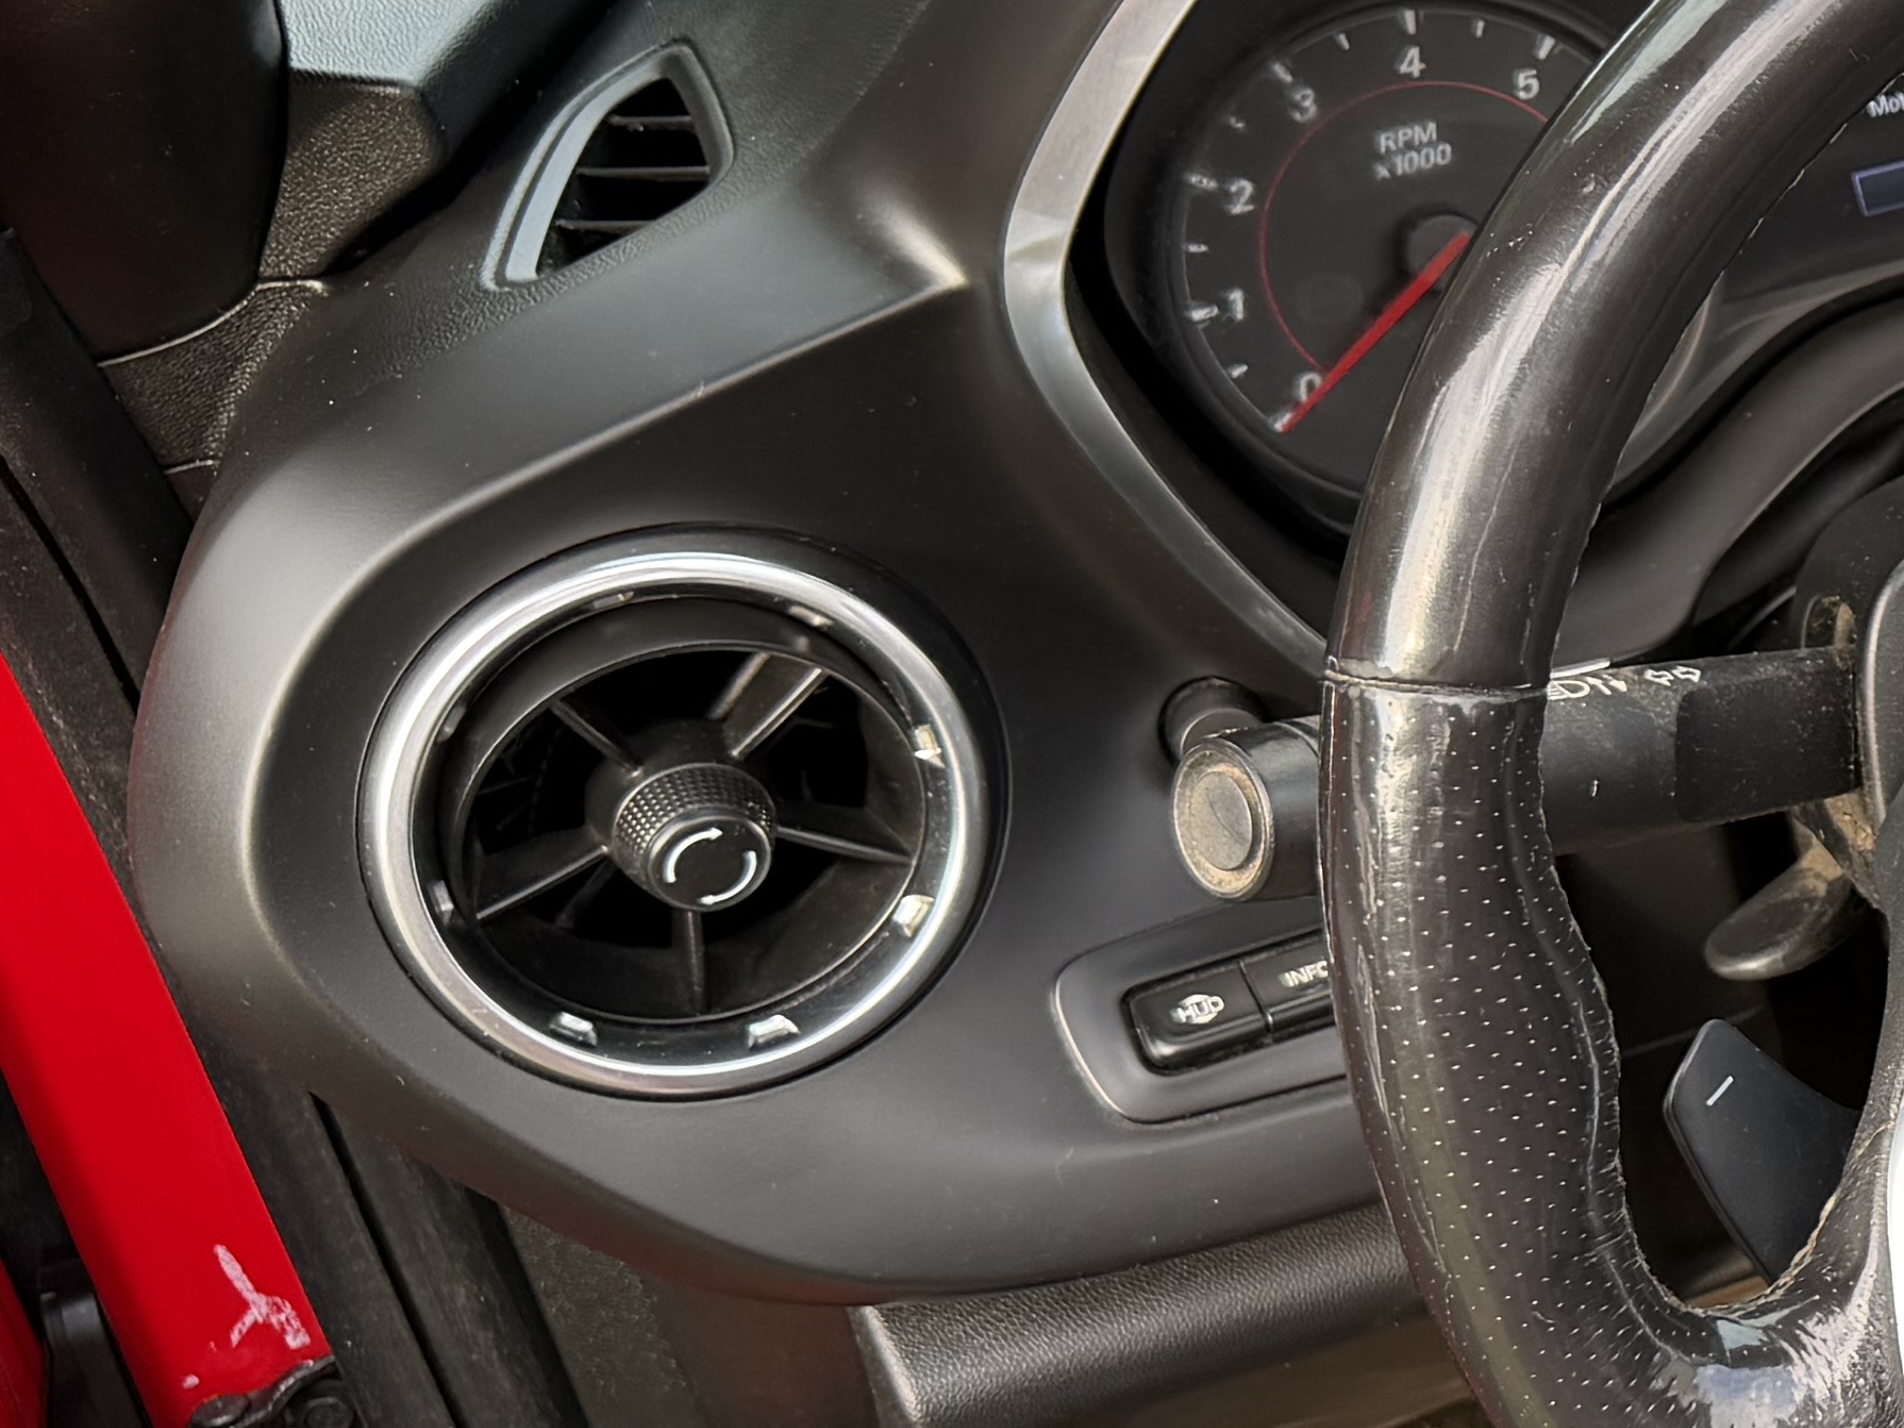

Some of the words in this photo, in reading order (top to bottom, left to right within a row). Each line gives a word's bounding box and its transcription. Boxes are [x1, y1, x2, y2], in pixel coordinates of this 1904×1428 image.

[1398, 45, 1425, 78] 4
[1513, 68, 1540, 99] 5
[1292, 89, 1318, 121] 3
[1379, 121, 1438, 154] RPM
[1227, 180, 1255, 213] 2
[1227, 290, 1246, 321] 1
[1171, 995, 1225, 1025] HUD
